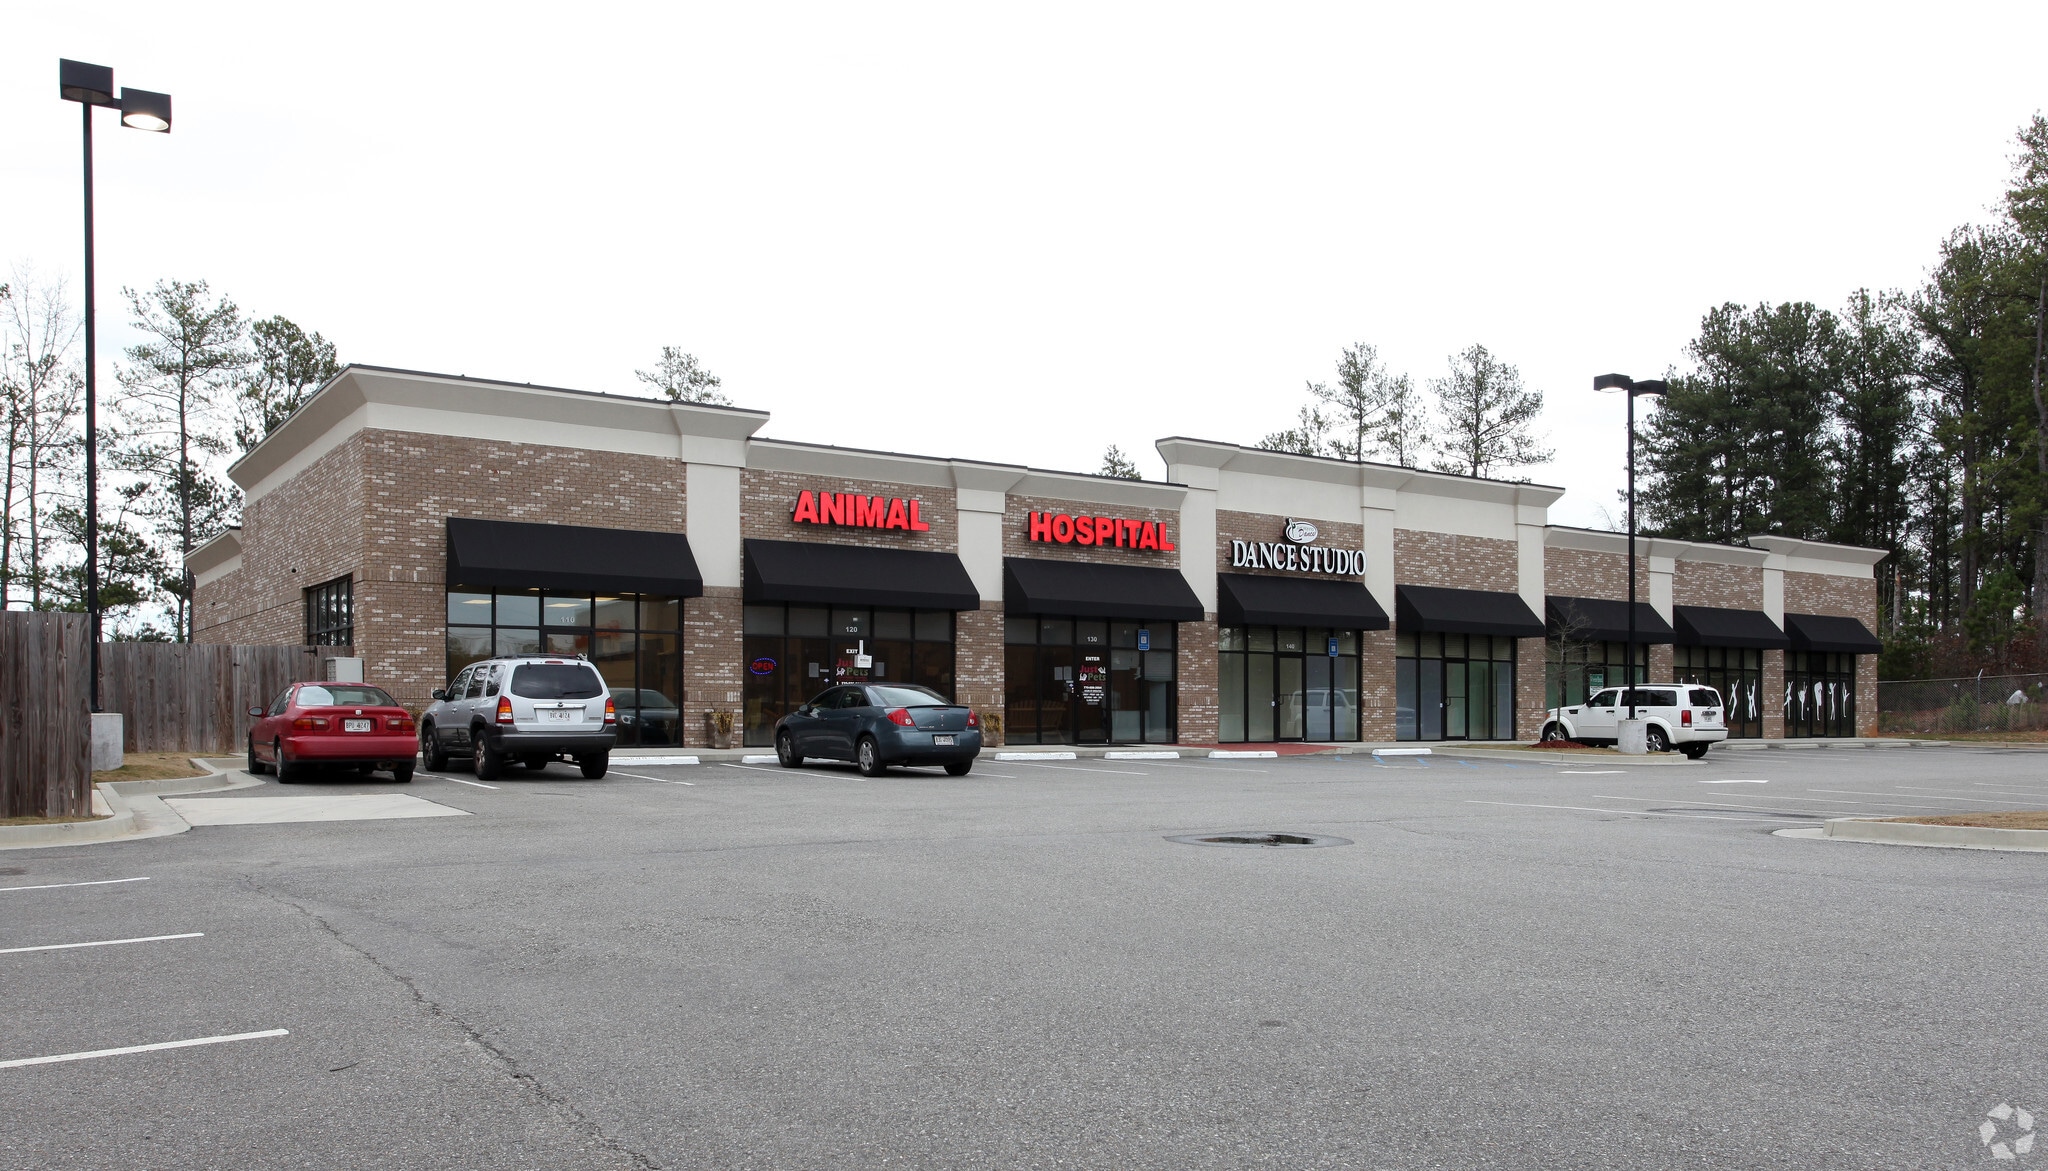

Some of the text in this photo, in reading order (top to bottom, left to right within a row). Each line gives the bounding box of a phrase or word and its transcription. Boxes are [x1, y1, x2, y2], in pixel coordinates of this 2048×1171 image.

[793, 490, 930, 532] ANIMAL
[1028, 511, 1175, 552] HOSPITAL
[1233, 540, 1367, 576] DANCE STUDIO
[752, 661, 775, 671] OPEN
[836, 658, 855, 667] Jus
[846, 667, 869, 676] Pets
[1079, 665, 1098, 673] Just
[1088, 673, 1106, 681] Pets
